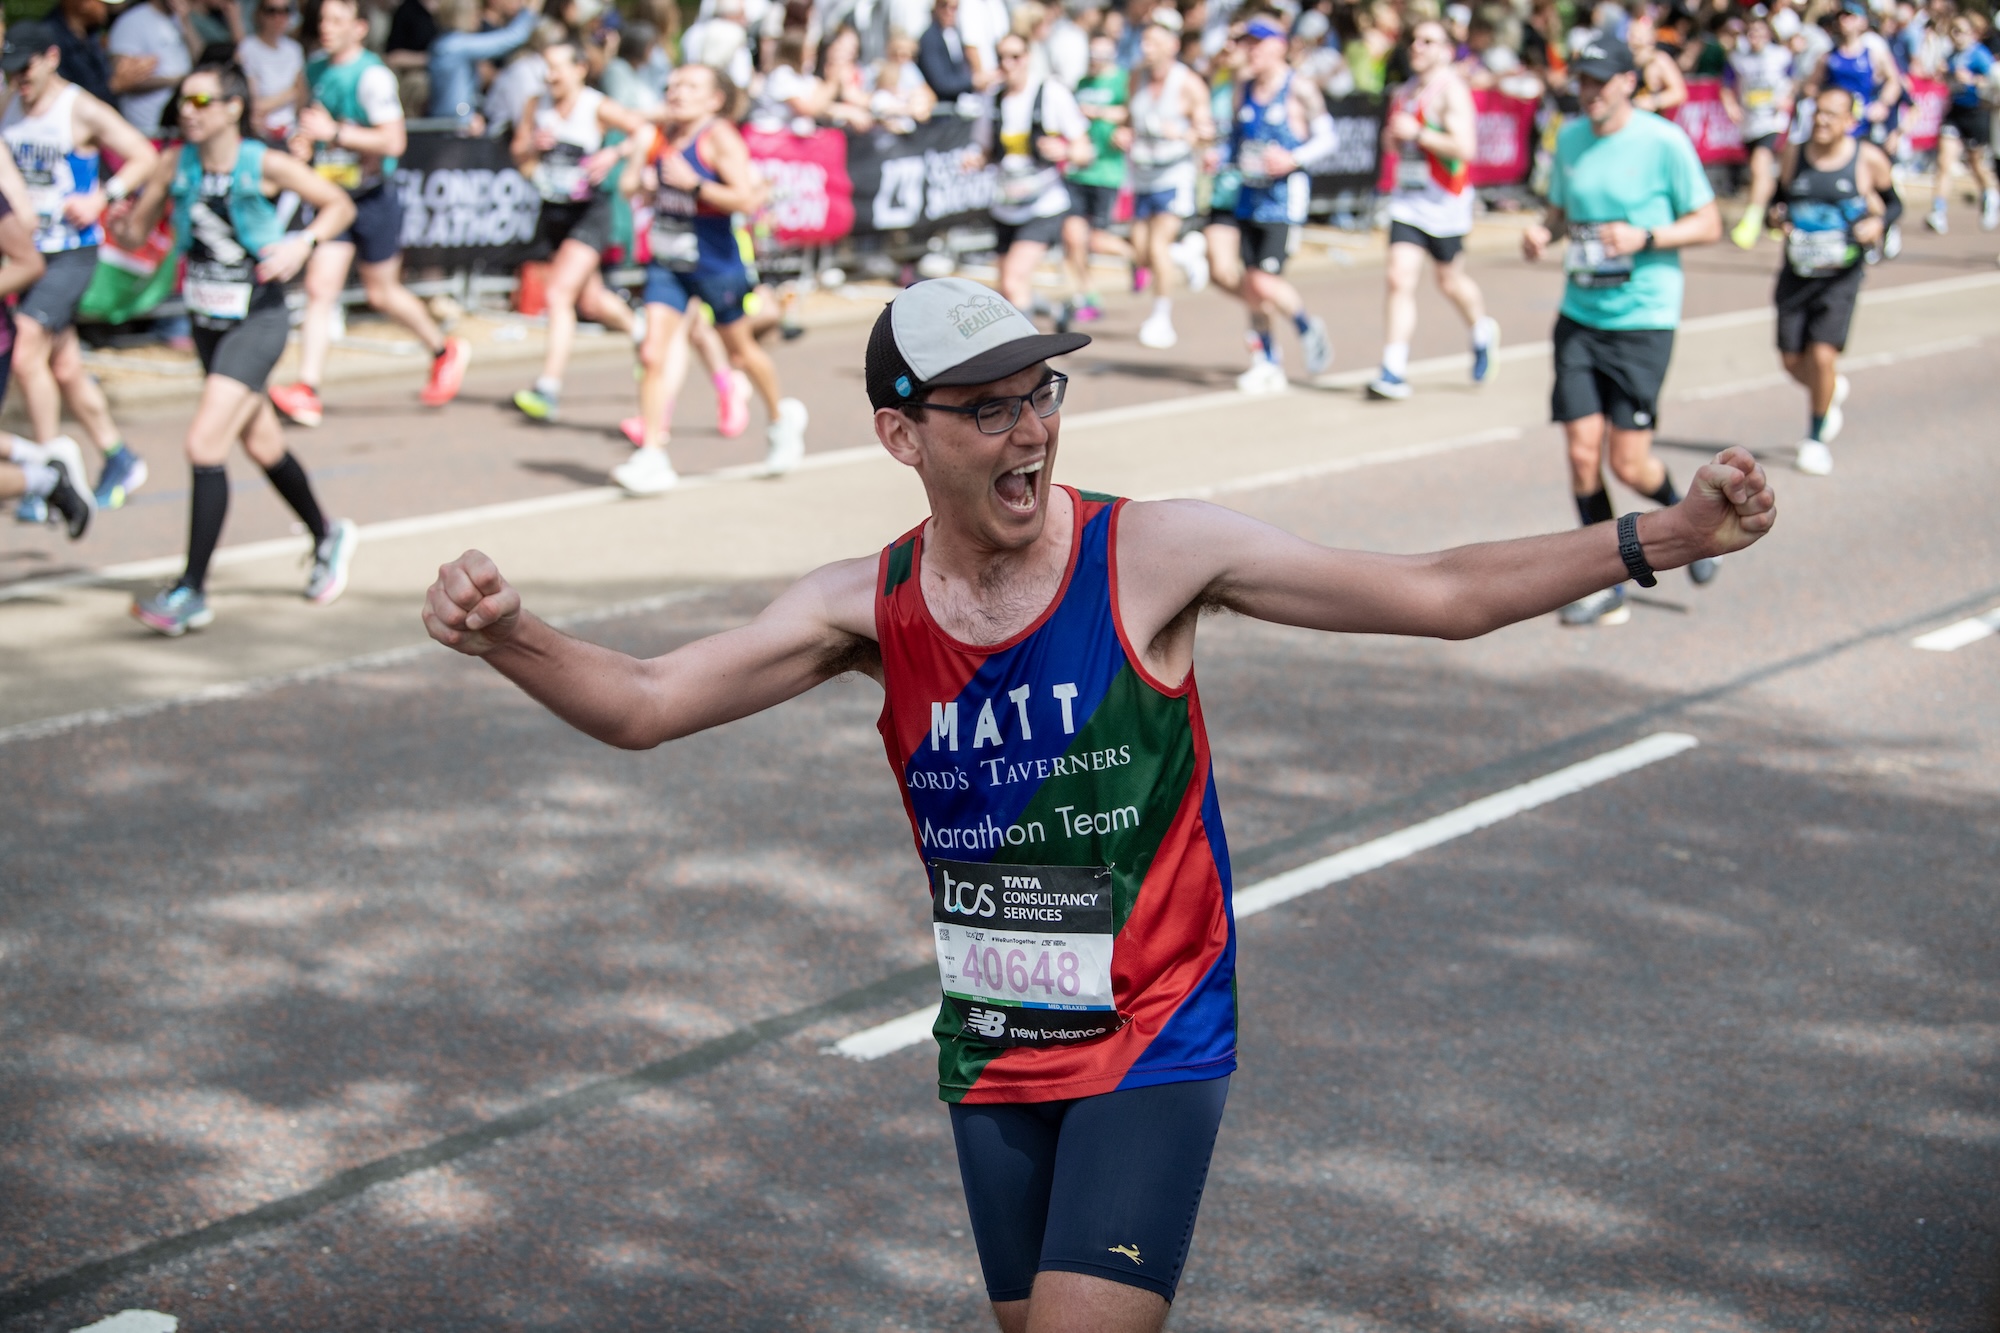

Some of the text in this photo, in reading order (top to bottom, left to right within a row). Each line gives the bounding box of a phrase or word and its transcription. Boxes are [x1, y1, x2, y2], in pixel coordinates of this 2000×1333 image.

[401, 204, 540, 247] RATHON
[931, 682, 1078, 751] MATT
[902, 745, 1131, 790] LORD'S TAVERNERS
[918, 805, 1139, 850] Marathon Team
[943, 869, 996, 917] tcs
[1001, 876, 1042, 890] TATA
[1002, 891, 1099, 907] CONSULTANCY
[1003, 907, 1063, 922] SERVICES
[962, 943, 1081, 997] 40648
[1010, 1027, 1106, 1040] new balance
